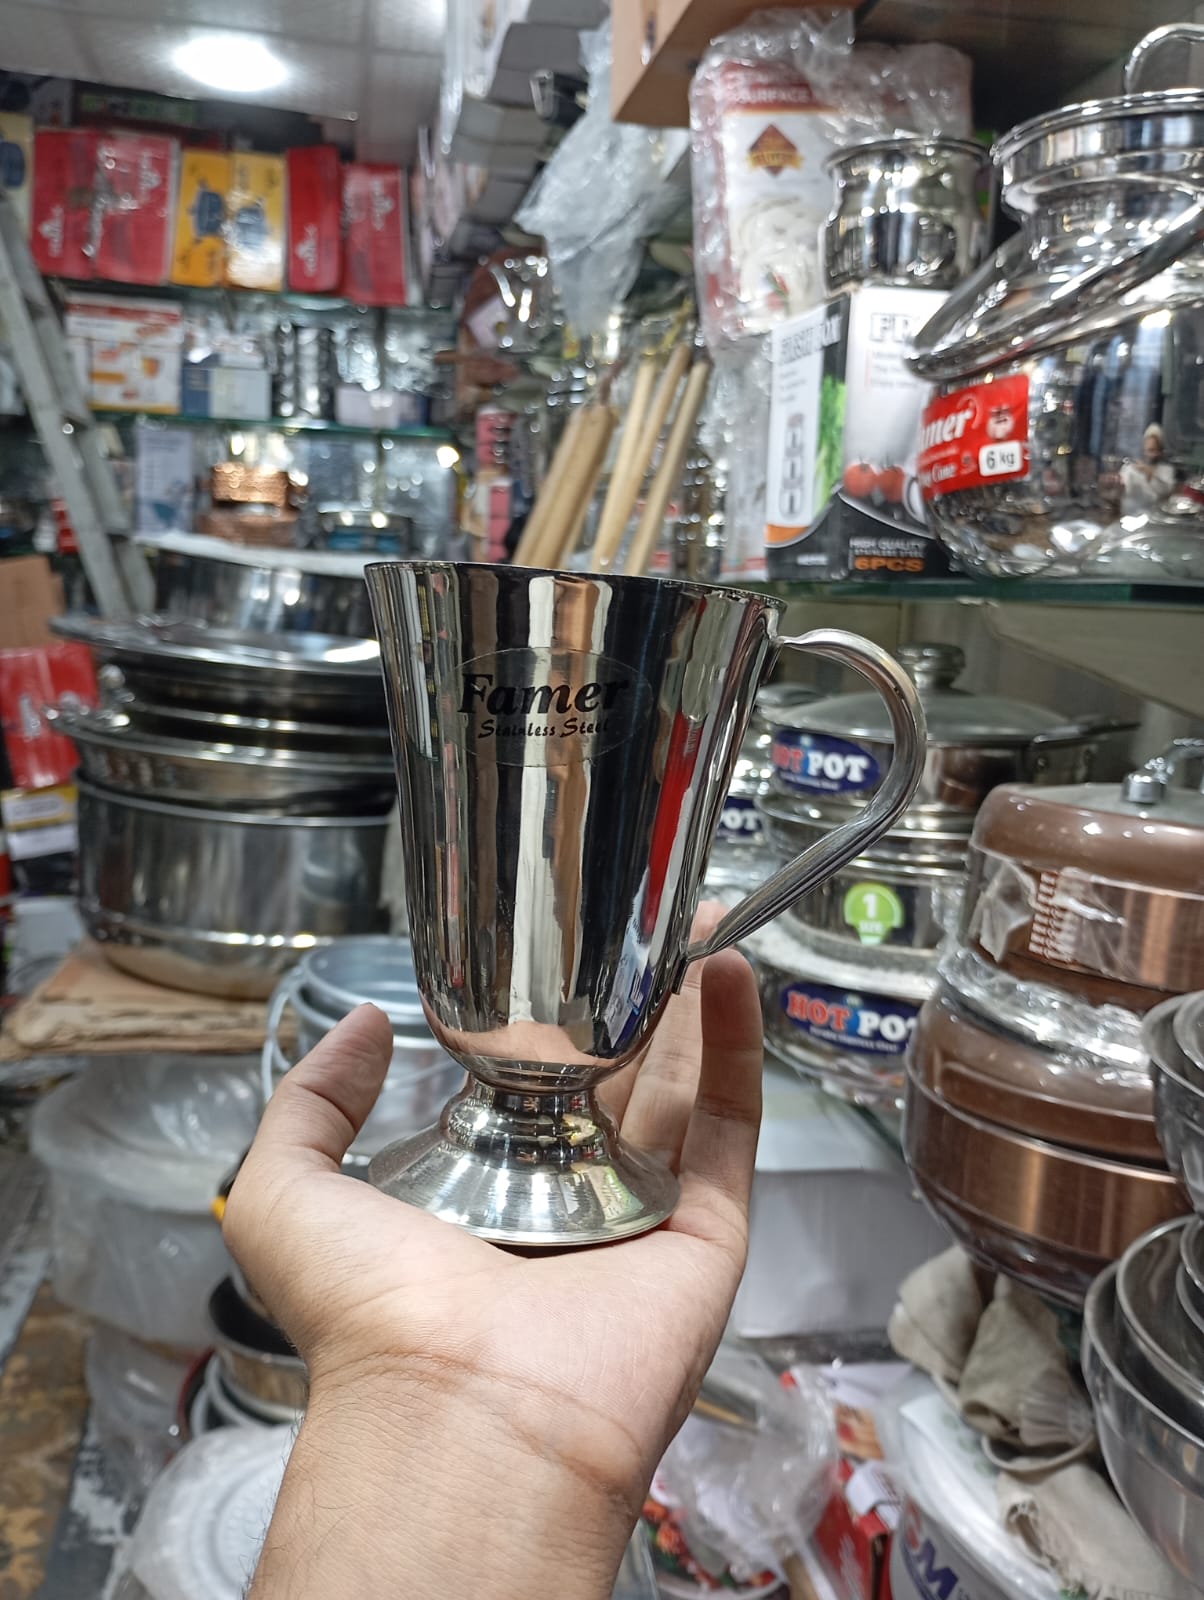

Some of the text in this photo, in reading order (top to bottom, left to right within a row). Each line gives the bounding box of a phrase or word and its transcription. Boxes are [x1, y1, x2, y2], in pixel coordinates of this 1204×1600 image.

[986, 450, 1001, 470] 6
[457, 673, 629, 716] Famer
[477, 717, 609, 738] Stainless Steel
[807, 751, 869, 782] POT
[720, 807, 763, 830] OT
[862, 893, 877, 919] 1
[787, 991, 849, 1032] HOT
